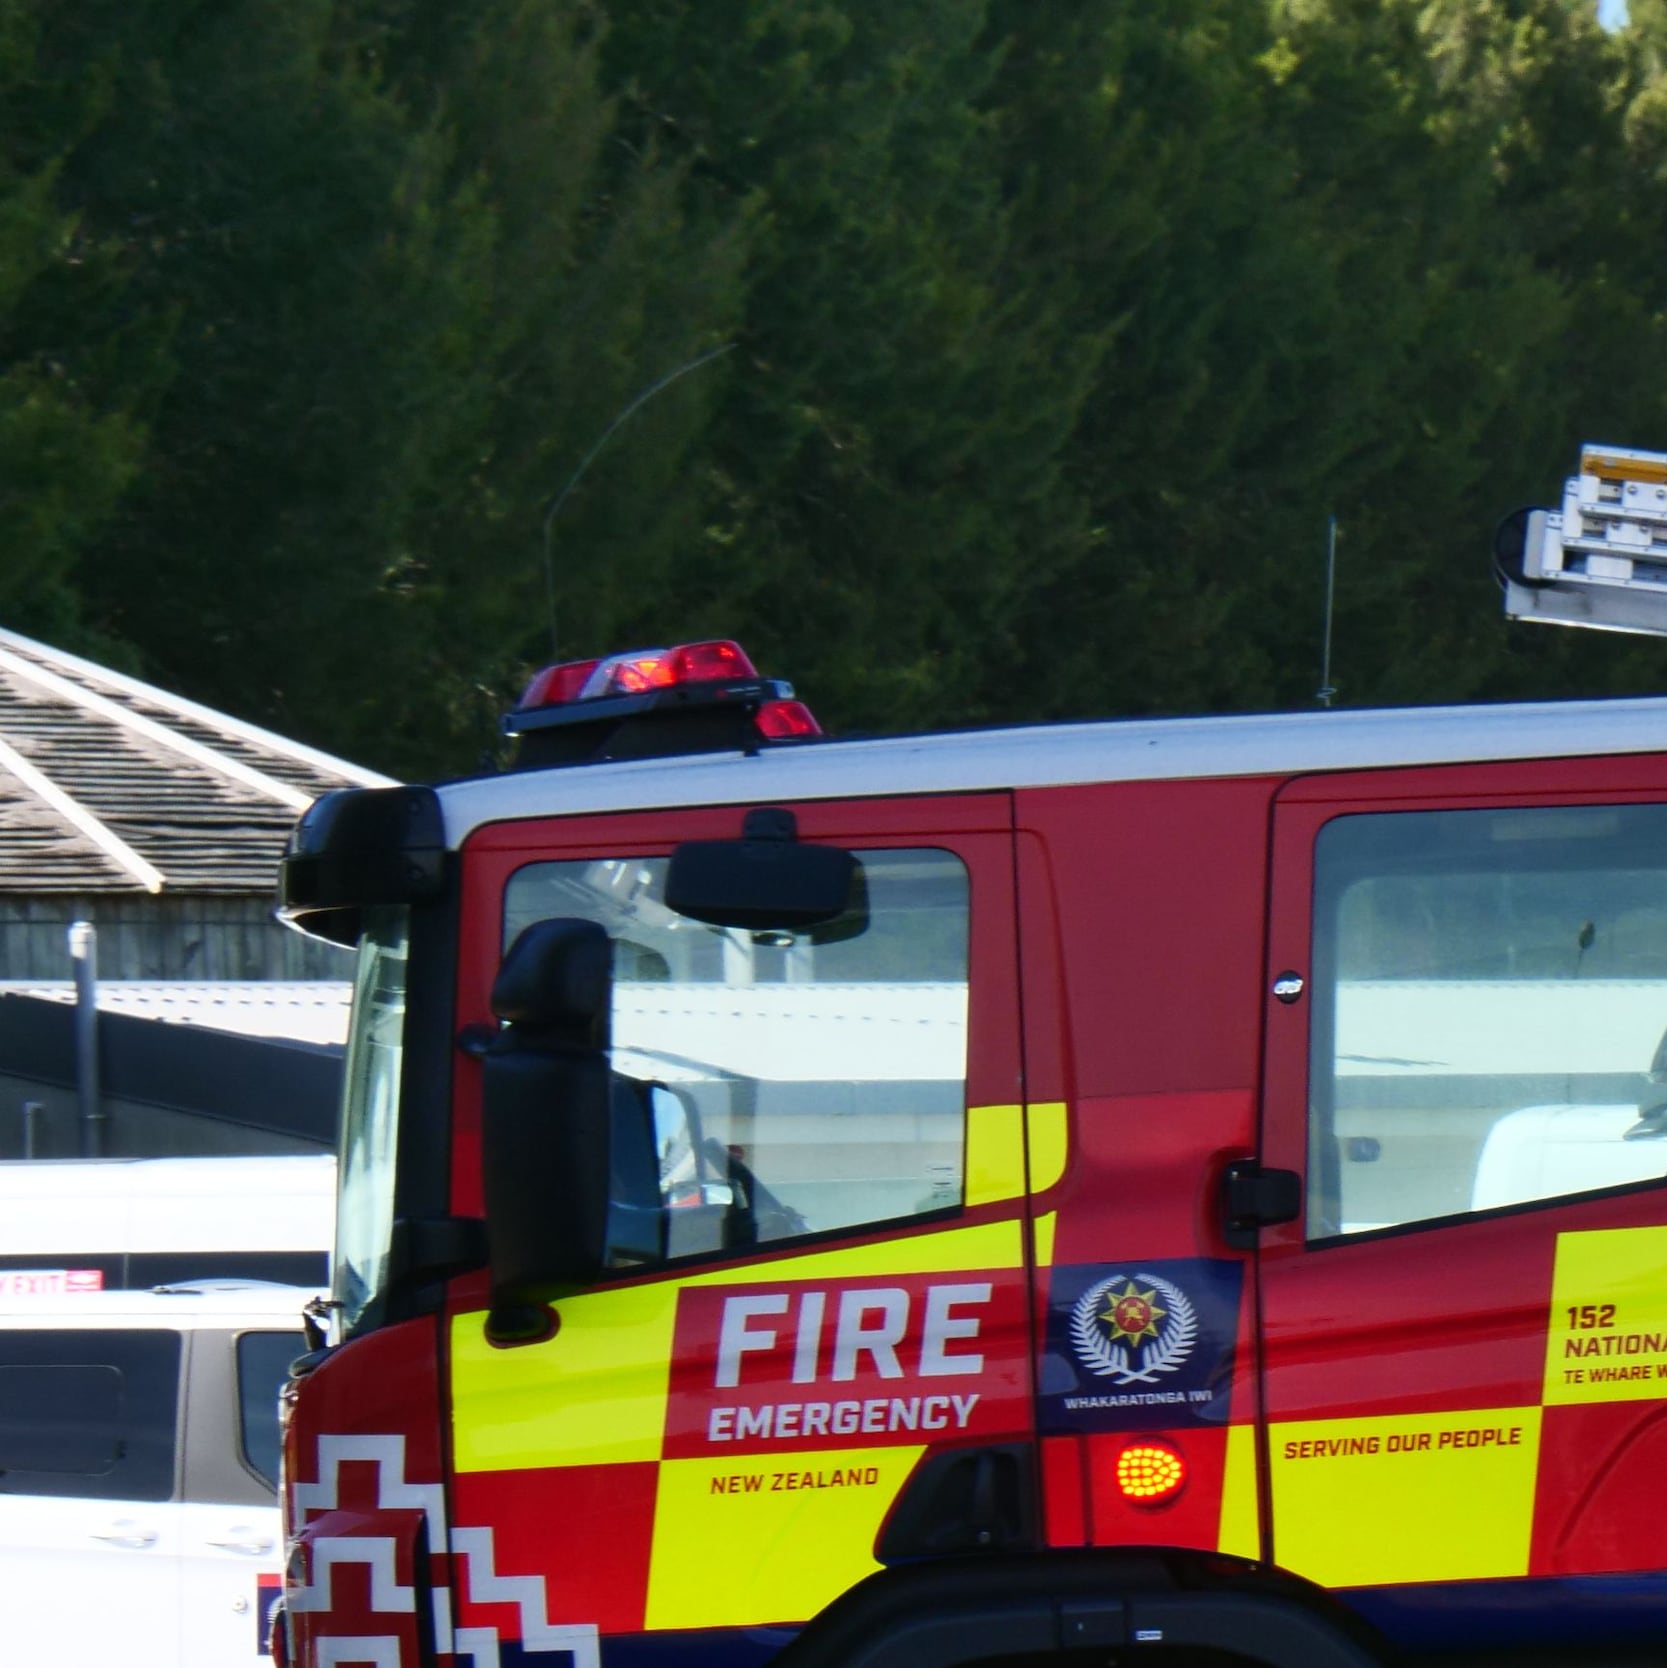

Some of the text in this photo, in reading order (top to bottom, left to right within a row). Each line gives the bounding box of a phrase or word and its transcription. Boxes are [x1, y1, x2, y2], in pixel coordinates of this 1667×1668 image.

[1567, 1304, 1616, 1330] 152
[715, 1283, 993, 1388] FIRE
[1564, 1369, 1584, 1384] TE
[1588, 1365, 1652, 1383] WHARE
[1064, 1390, 1213, 1409] WHAKARATONGA IWI
[708, 1394, 981, 1441] EMERGENCY
[1284, 1427, 1522, 1459] SERVING OUR PEOPLE
[711, 1467, 879, 1494] NEW ZEALAND
